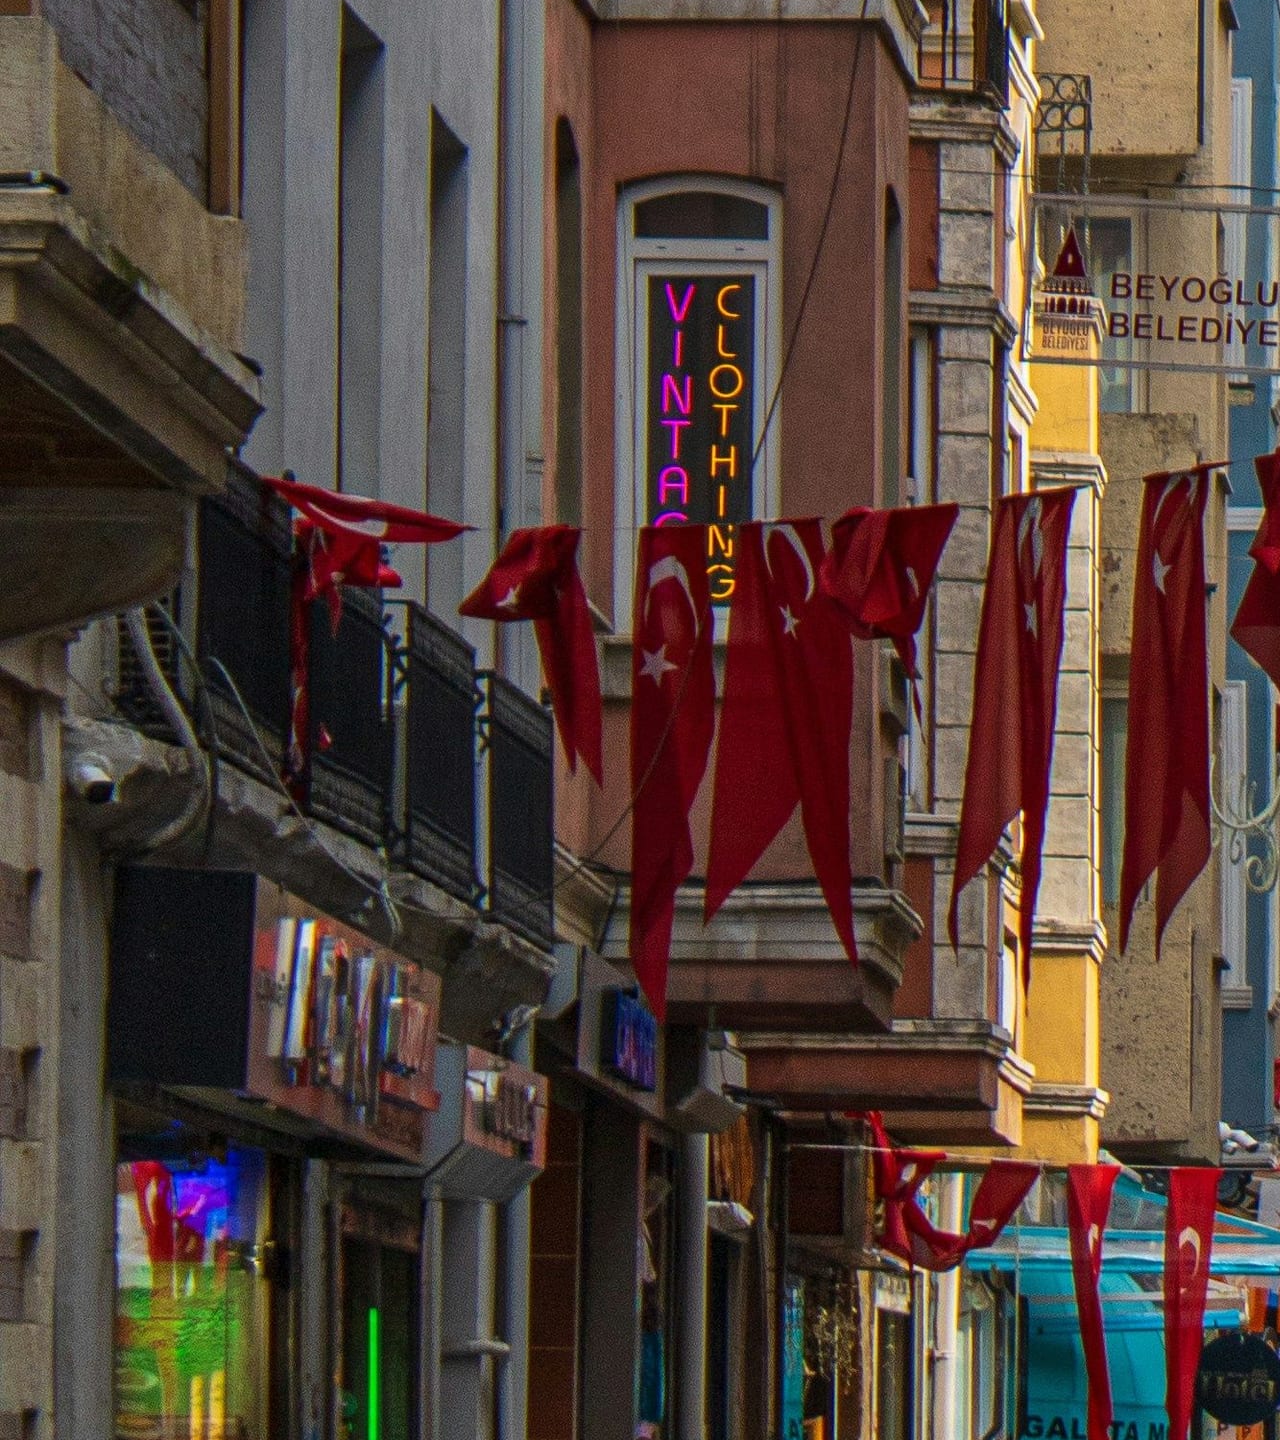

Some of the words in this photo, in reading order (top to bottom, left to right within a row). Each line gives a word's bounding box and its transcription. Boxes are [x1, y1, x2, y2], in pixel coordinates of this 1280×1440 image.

[653, 283, 697, 528] VINTA
[1111, 272, 1279, 307] BEYOĞLU
[706, 284, 744, 599] CLOTHING
